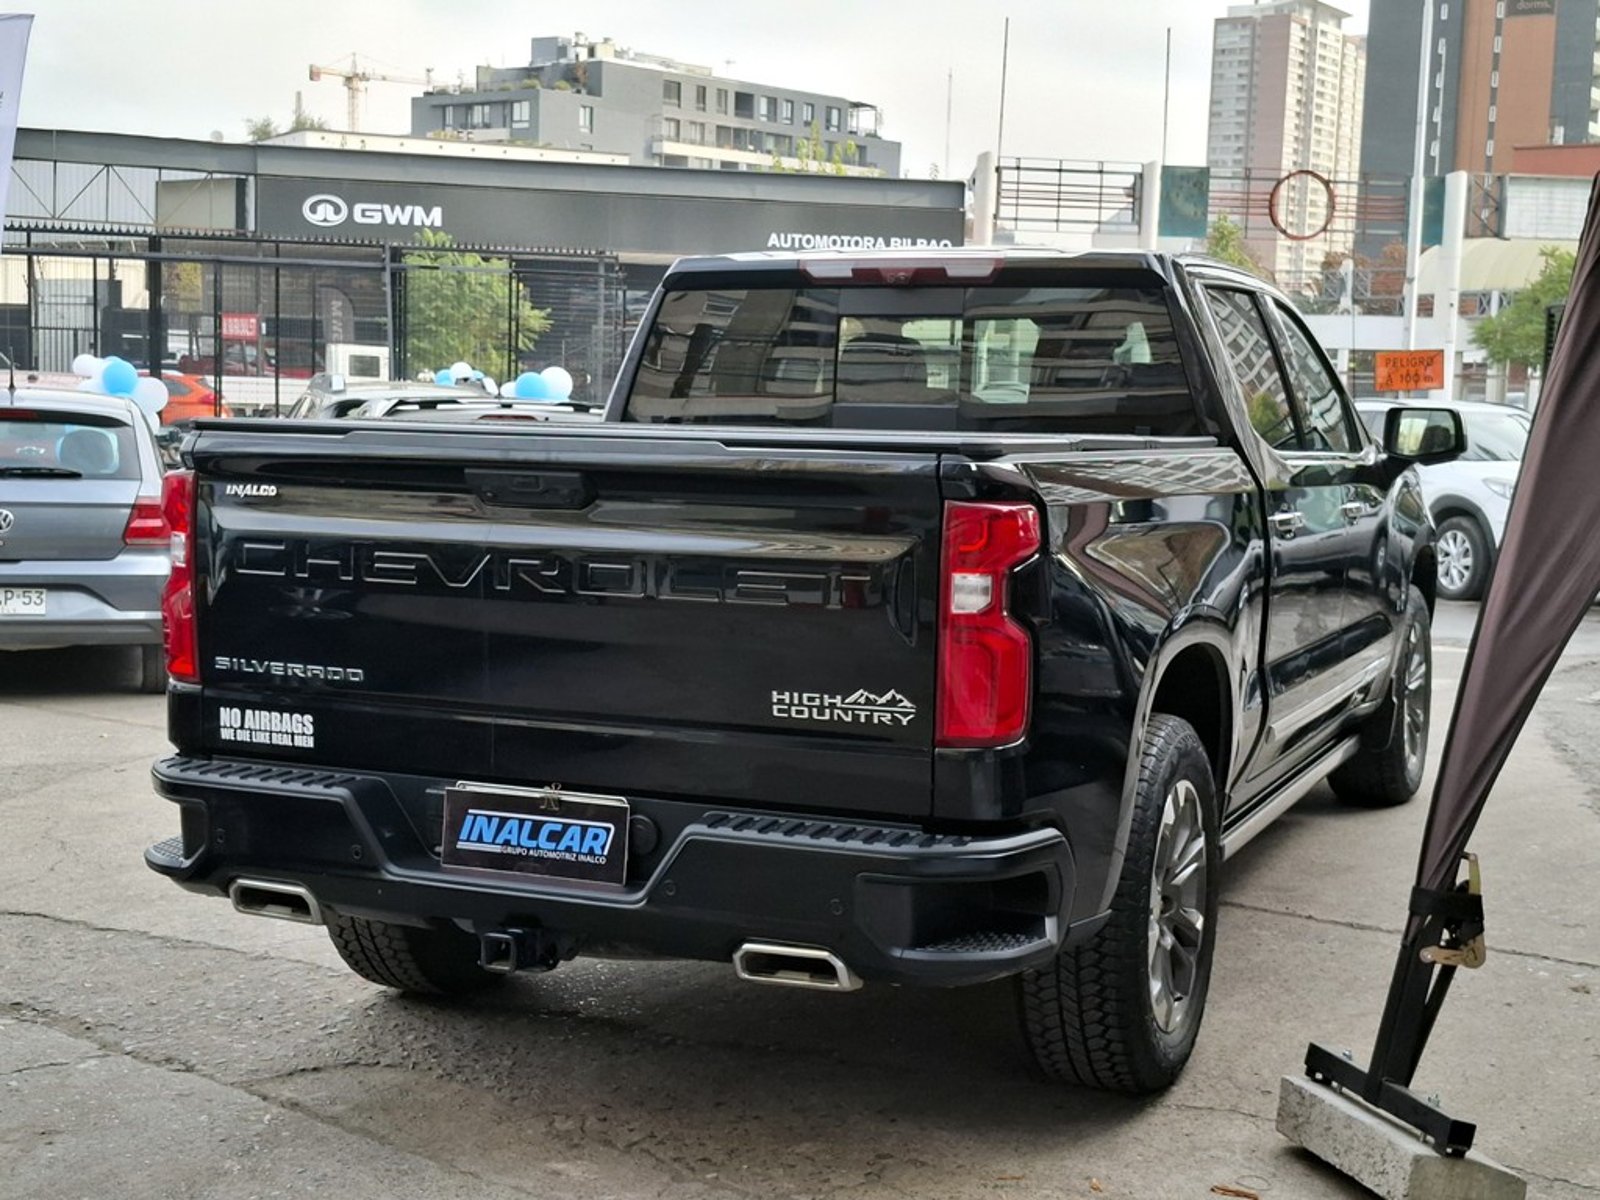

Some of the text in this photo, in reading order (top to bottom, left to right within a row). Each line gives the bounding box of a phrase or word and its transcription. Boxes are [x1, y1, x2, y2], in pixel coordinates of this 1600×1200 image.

[353, 202, 442, 227] GWM
[767, 232, 952, 249] AUTOMOTORA BILBAO
[1385, 356, 1434, 368] PELIGRO
[226, 484, 277, 498] INALCO
[235, 541, 872, 608] CHEVROLET
[214, 656, 364, 682] SILVERADO
[771, 690, 842, 707] HIGH
[219, 706, 314, 735] NO AIRBAGS
[772, 704, 915, 726] COUNTRY
[220, 728, 315, 748] WE DIE LIKE REAL MEN
[459, 815, 608, 855] INALCAR
[501, 845, 607, 865] GRUPO AUTOMOTRIZ INALCO
